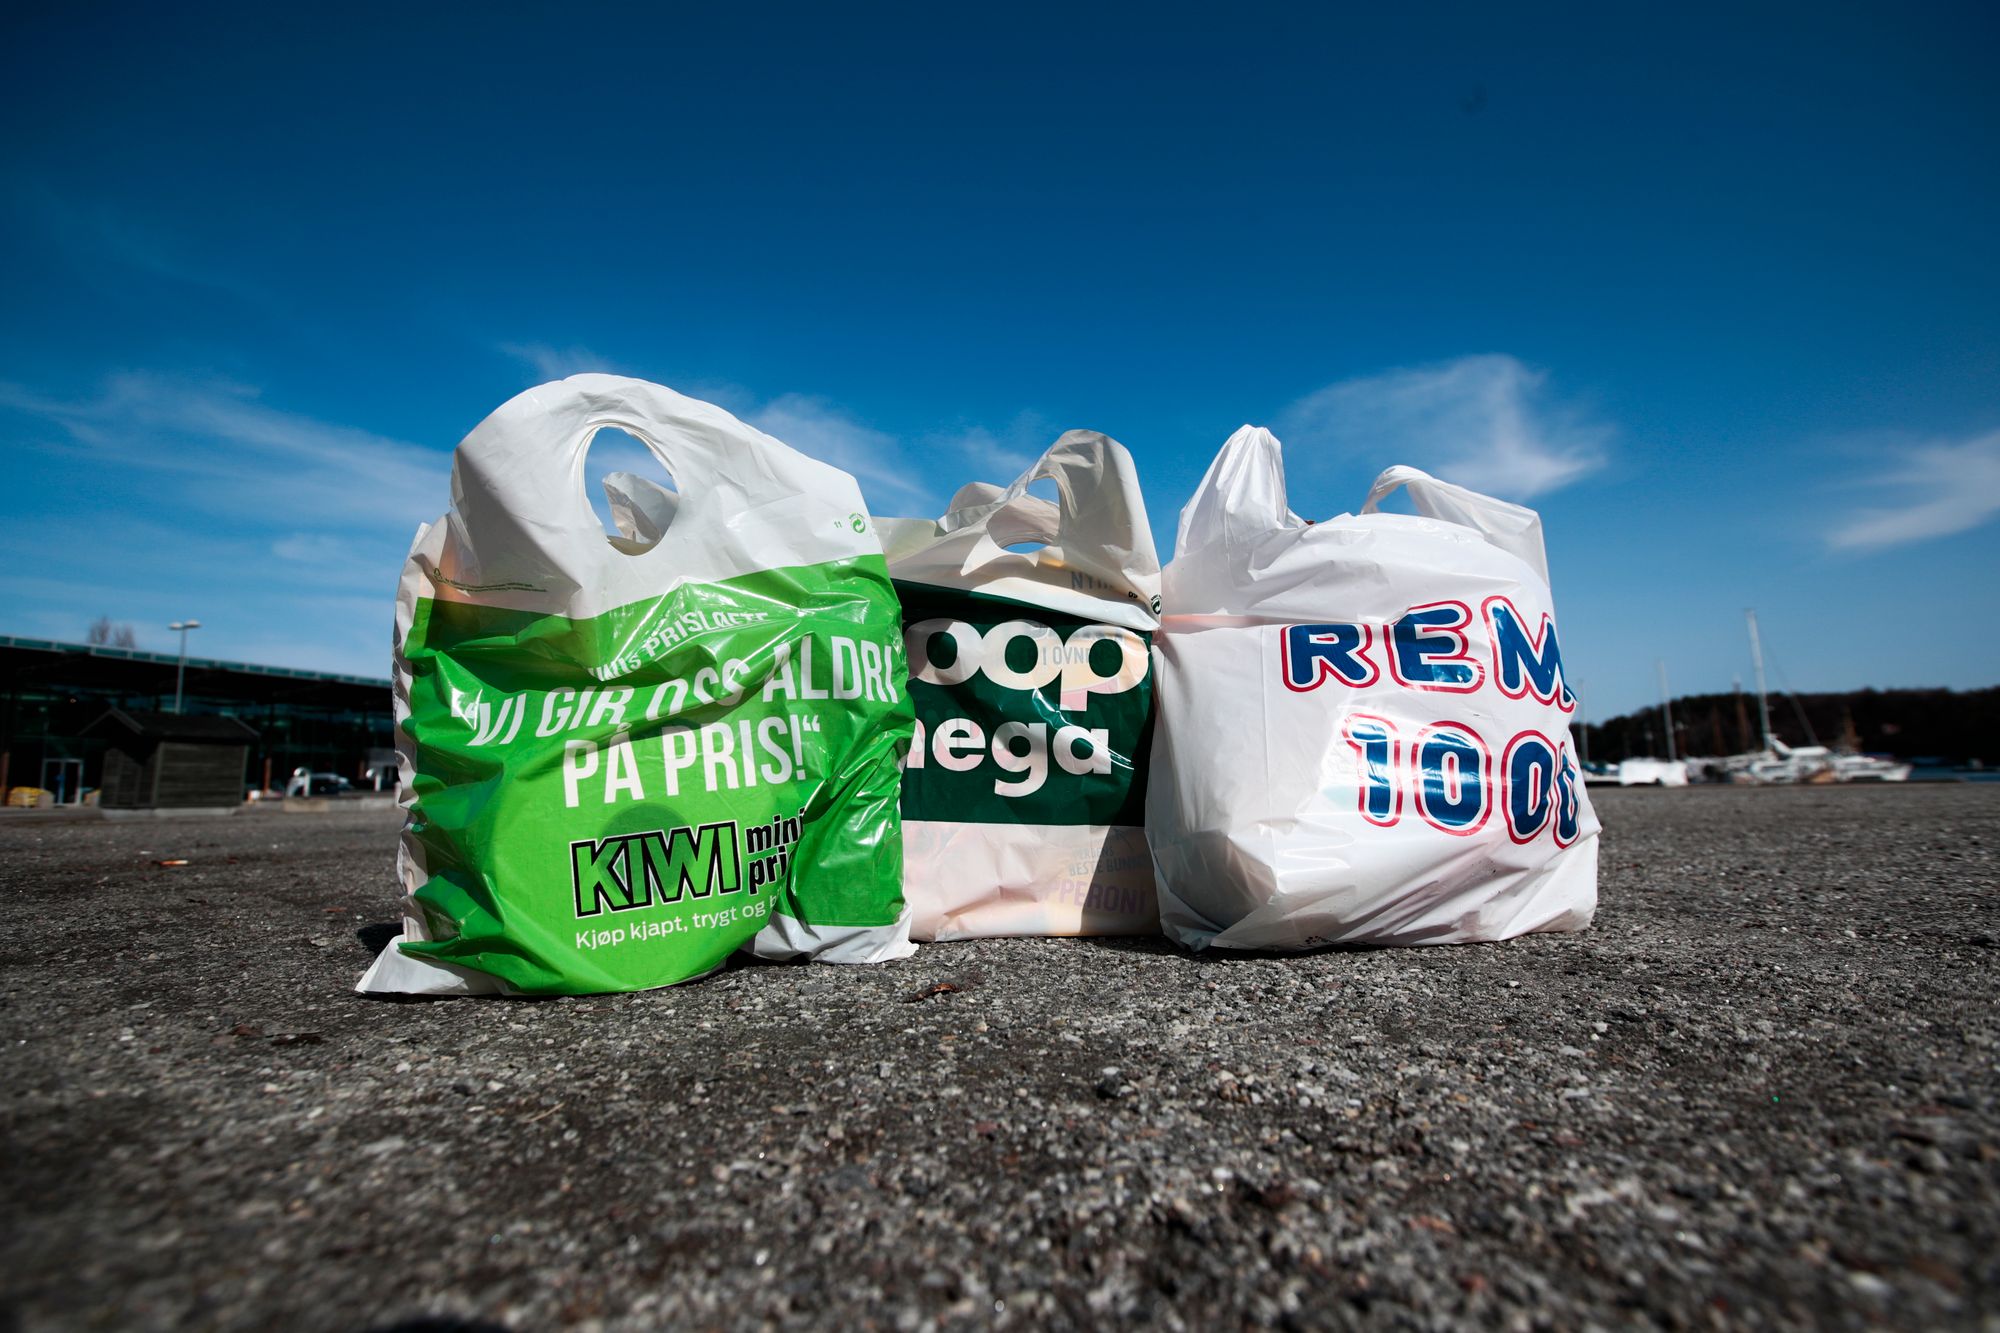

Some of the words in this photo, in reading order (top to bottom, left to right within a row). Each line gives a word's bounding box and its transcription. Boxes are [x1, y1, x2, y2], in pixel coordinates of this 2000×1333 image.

[535, 685, 634, 737] GIR
[763, 635, 898, 704] ALDRI
[901, 617, 1150, 712] oop
[563, 721, 645, 808] PÅ
[1342, 713, 1580, 849] 1000
[570, 820, 742, 919] KIWI
[576, 928, 625, 950] Kjøp
[630, 916, 688, 942] kjapt,
[692, 905, 738, 929] trygt
[742, 900, 766, 918] og
